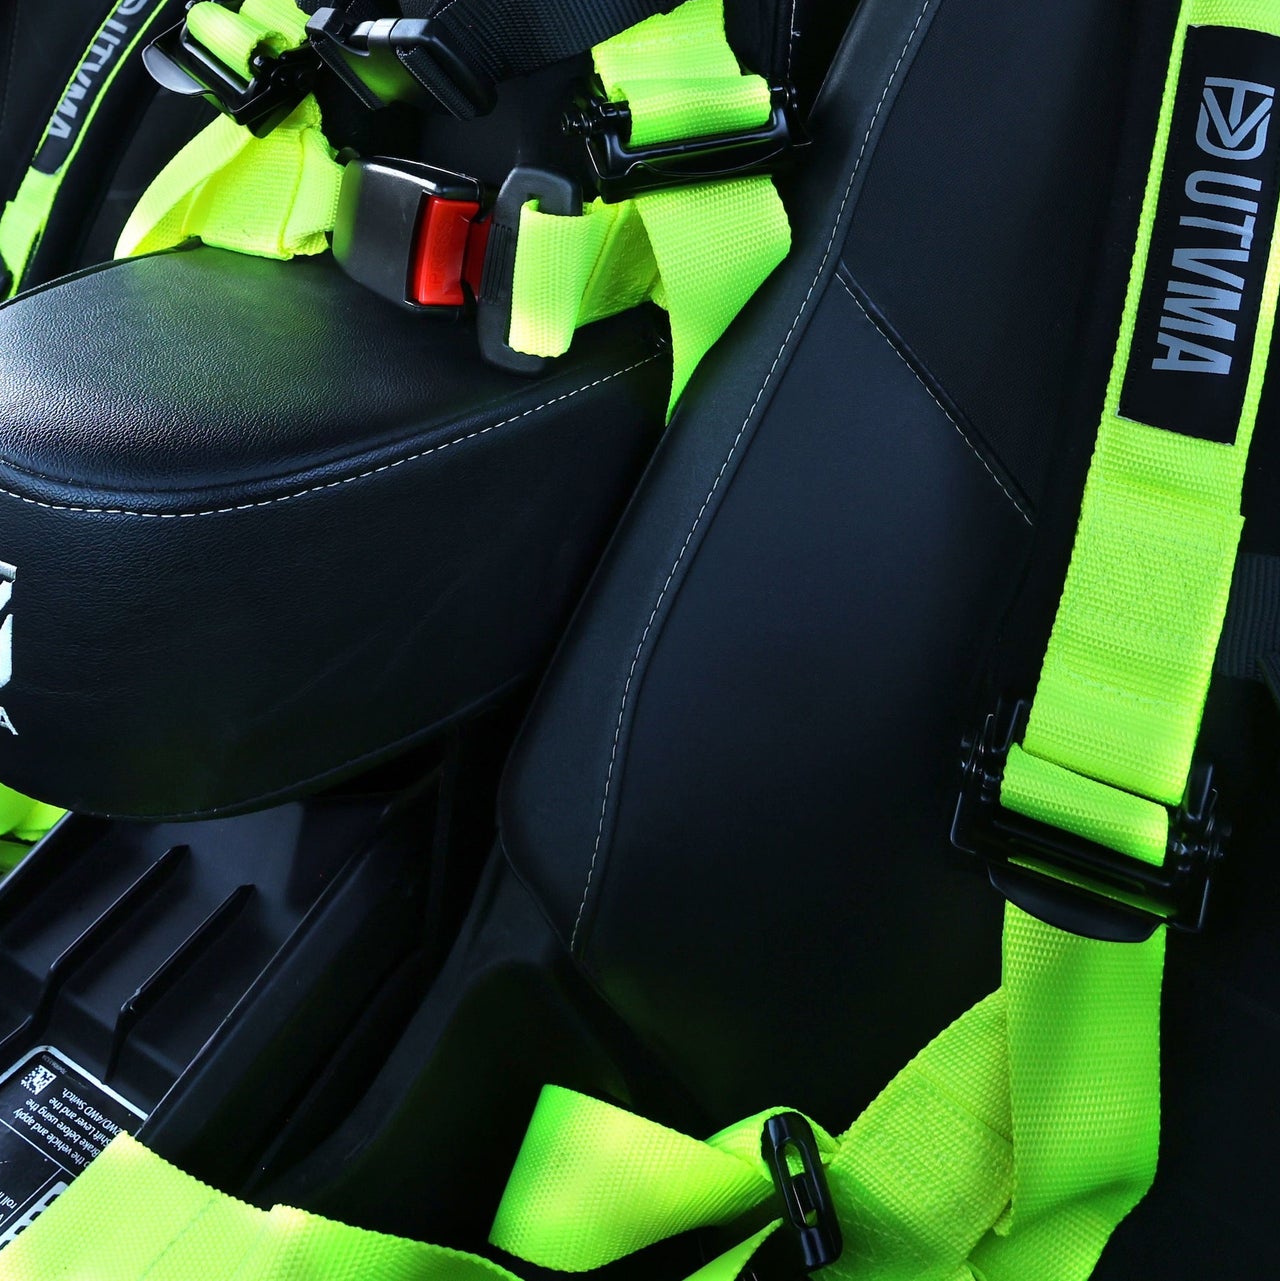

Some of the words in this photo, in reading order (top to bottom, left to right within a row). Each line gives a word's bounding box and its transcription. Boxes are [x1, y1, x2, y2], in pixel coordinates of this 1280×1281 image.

[48, 22, 133, 140] UTVMA
[1151, 171, 1264, 375] UTVMA
[25, 1098, 40, 1112] the
[48, 1097, 63, 1110] the
[62, 1087, 88, 1110] Switch.
[12, 1107, 36, 1126] apply
[37, 1105, 59, 1125] using
[58, 1106, 78, 1120] and
[83, 1106, 123, 1138] 2WD/4WD
[30, 1122, 49, 1136] and
[56, 1121, 82, 1144] before
[74, 1116, 96, 1136] Lever
[46, 1132, 73, 1155] vehicle
[78, 1138, 101, 1158] Brake
[70, 1151, 85, 1165] the
[0, 1195, 18, 1210] roll
